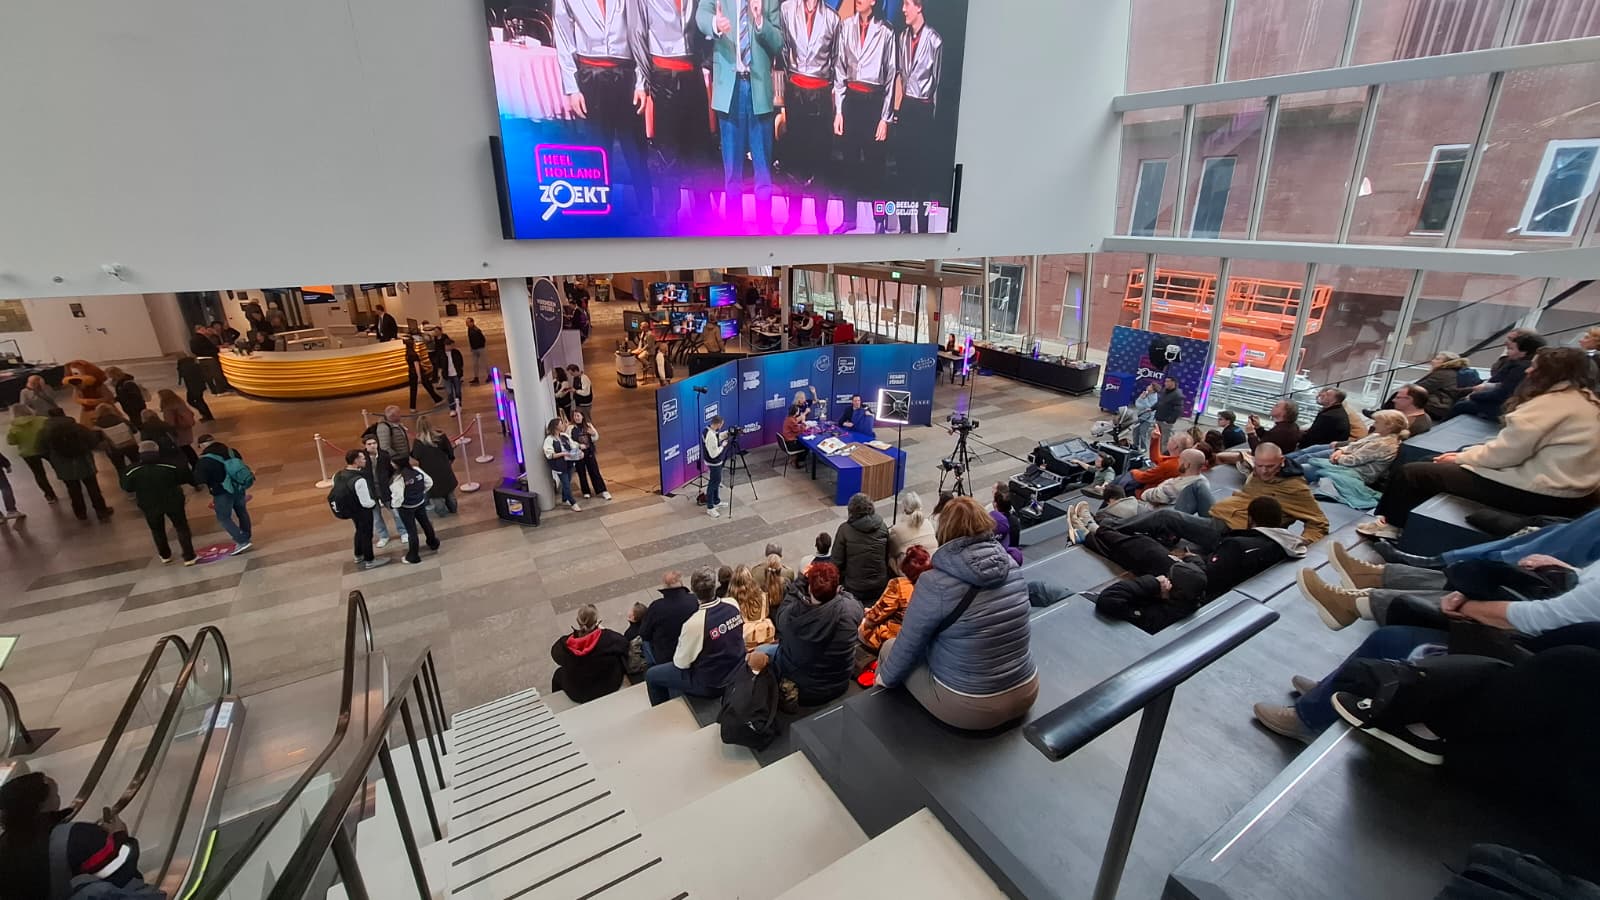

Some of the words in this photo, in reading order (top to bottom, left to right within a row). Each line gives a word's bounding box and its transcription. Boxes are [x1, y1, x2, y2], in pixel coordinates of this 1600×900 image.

[544, 154, 574, 166] HEEL
[545, 167, 601, 179] HOLLAND
[539, 180, 610, 208] ZOEKT
